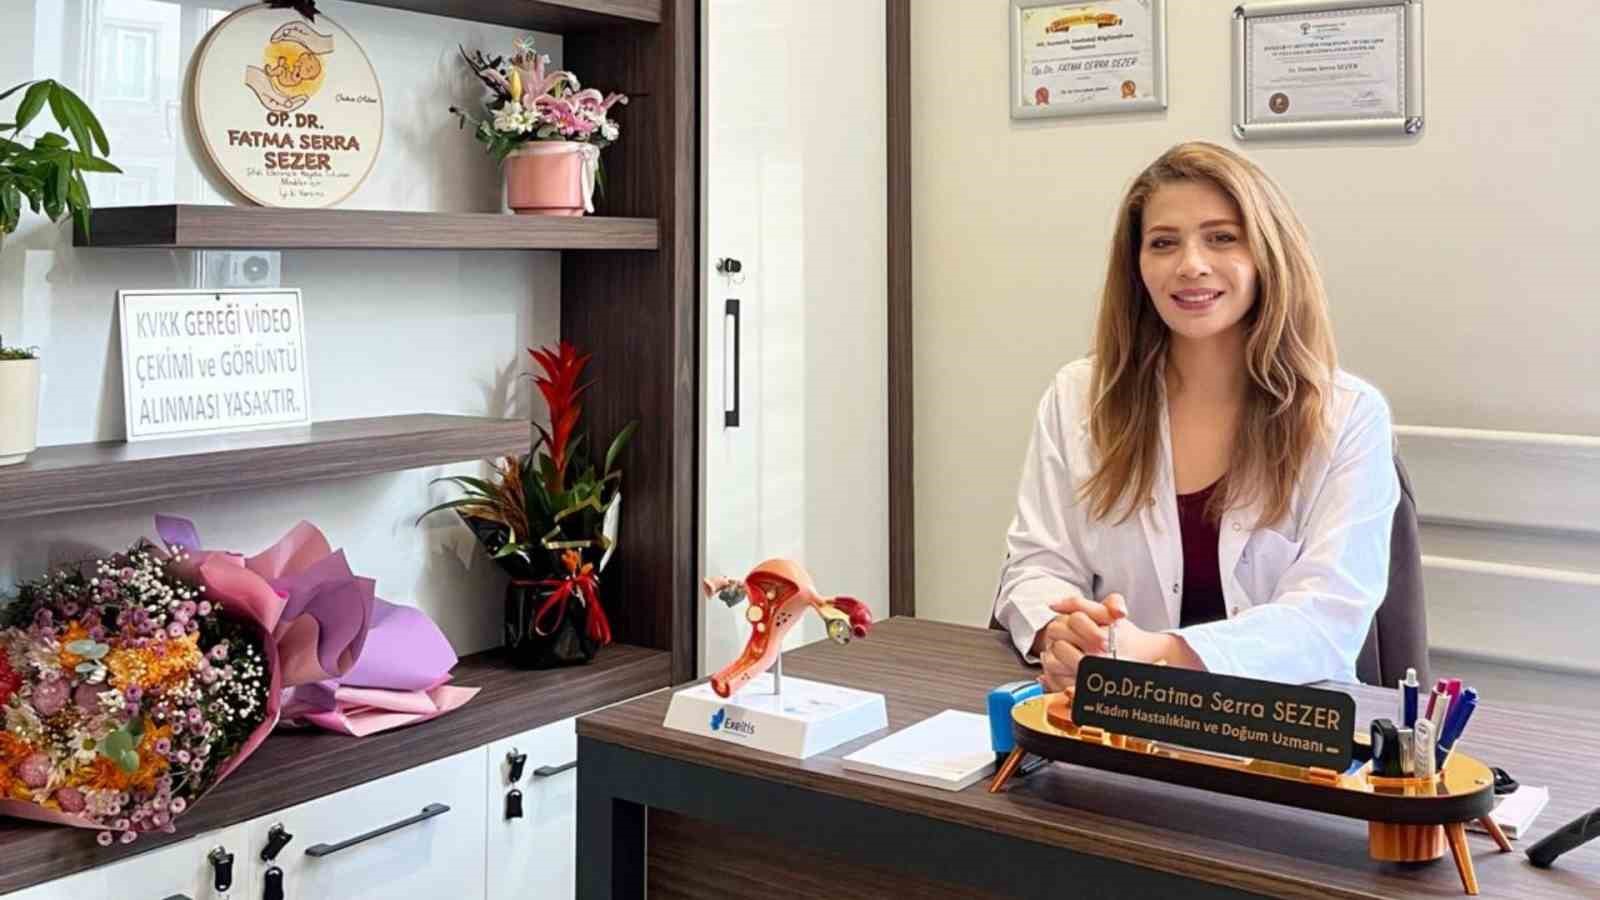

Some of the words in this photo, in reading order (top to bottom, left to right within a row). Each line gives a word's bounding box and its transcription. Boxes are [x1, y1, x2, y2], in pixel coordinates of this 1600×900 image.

[266, 112, 292, 128] OP.
[295, 113, 325, 130] DR.
[227, 129, 295, 149] FATMA
[300, 134, 360, 151] SERRA
[264, 151, 332, 171] SEZER
[136, 311, 181, 338] KVKK
[184, 303, 241, 336] GEREĞİ
[245, 303, 292, 333] VİDEO
[136, 346, 194, 389] ÇEKİMİ
[198, 357, 216, 378] ve
[220, 341, 298, 377] GÖRÜNTÜ
[140, 392, 220, 425] ALINMASI
[224, 388, 301, 417] YASAKTIR.
[1210, 691, 1265, 719] Serra
[1272, 700, 1342, 731] SEZER
[1131, 708, 1201, 730] Hastalıkları
[1202, 722, 1219, 735] ve
[1221, 723, 1269, 743] Doğum
[1271, 730, 1323, 753] Uzmanı
